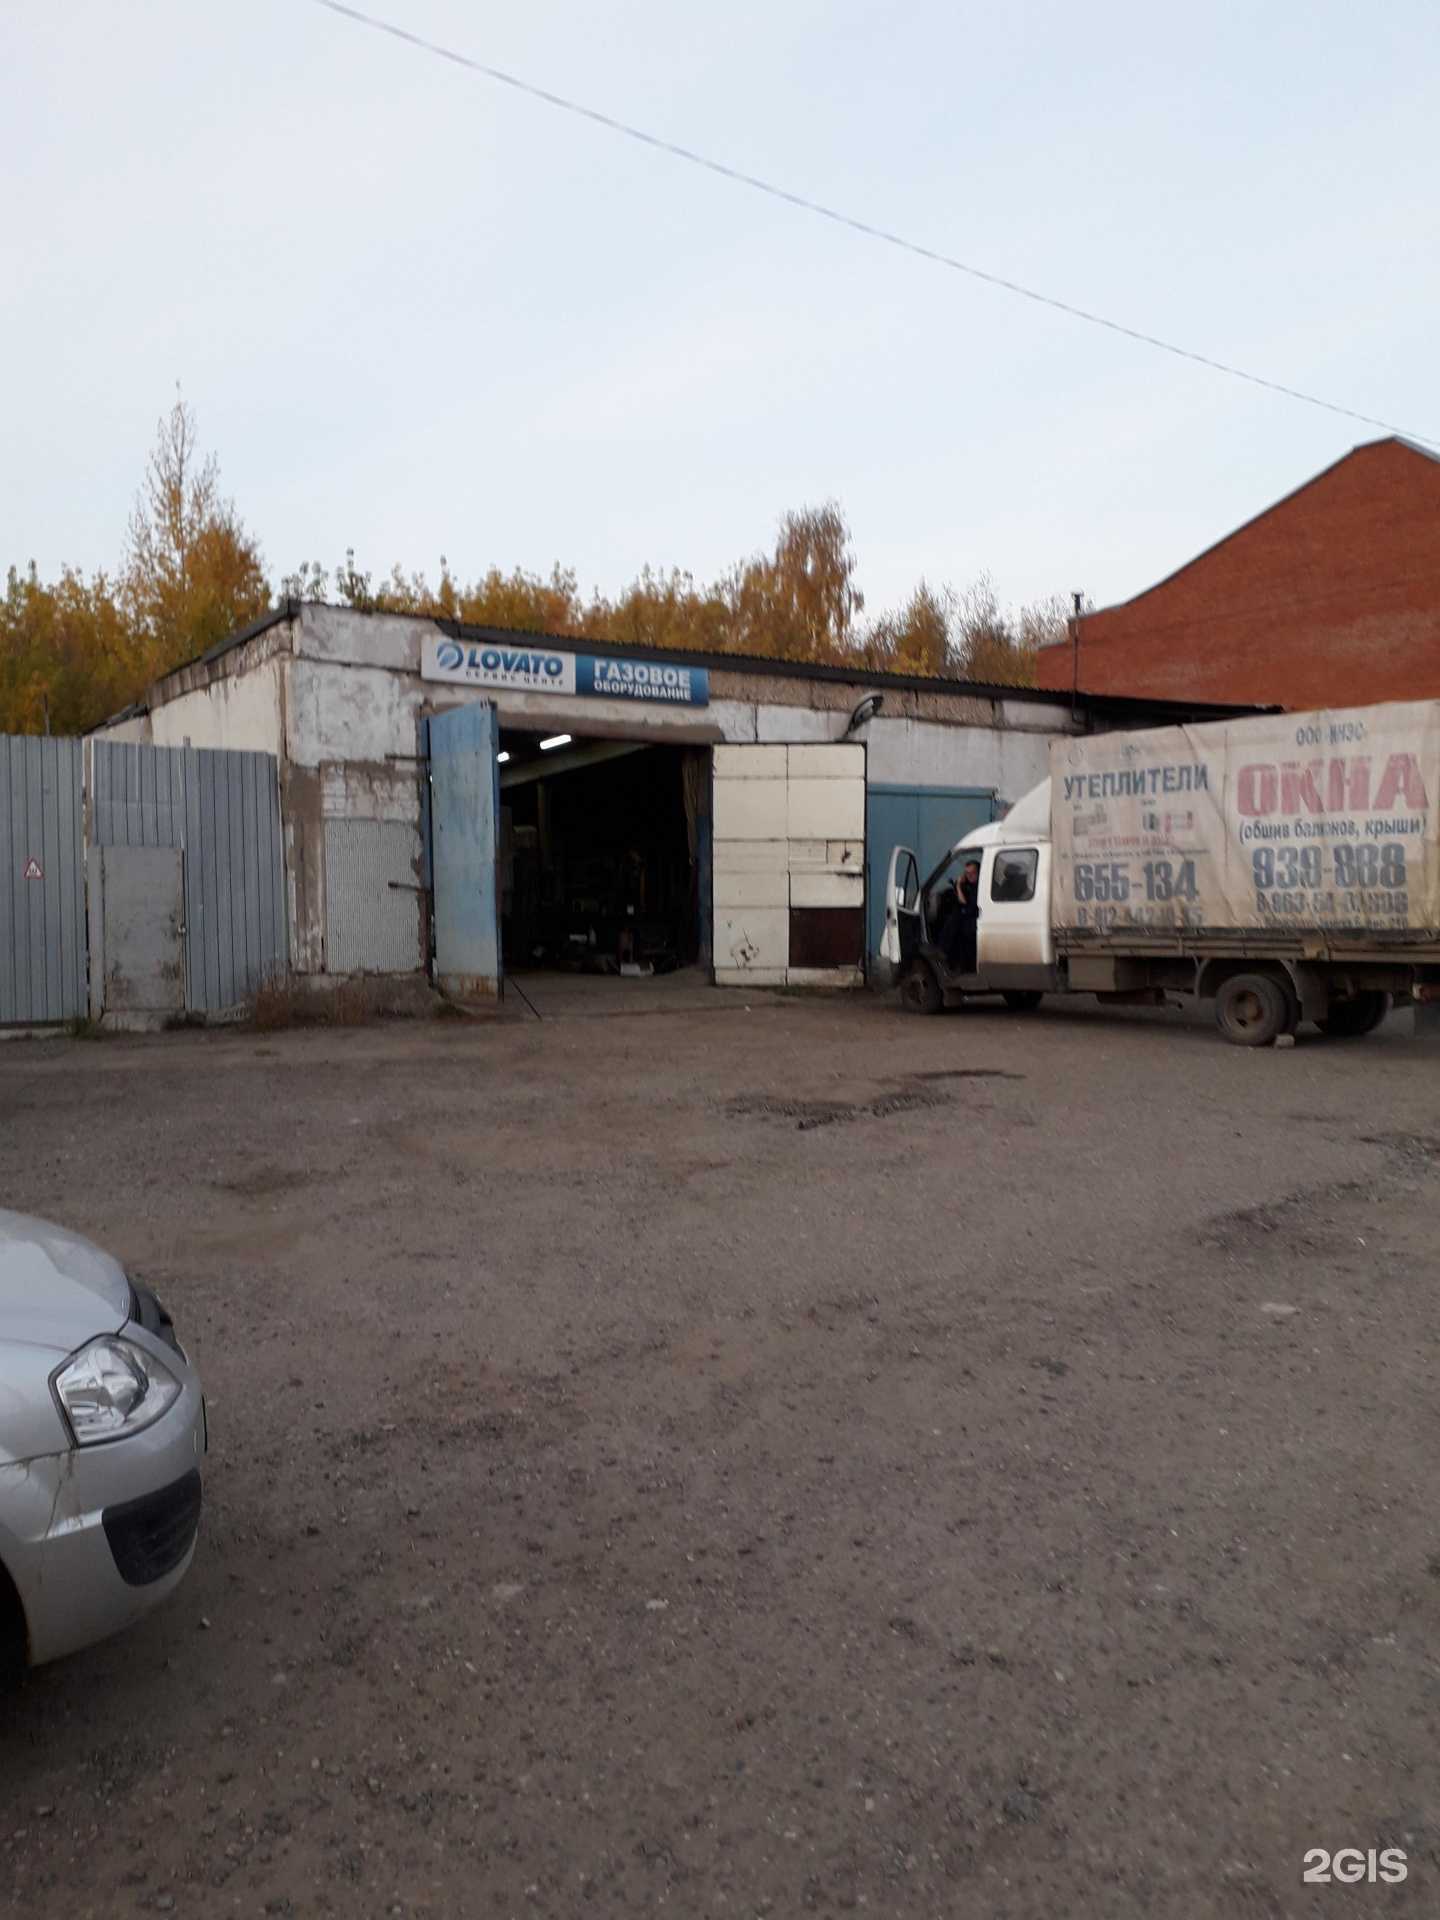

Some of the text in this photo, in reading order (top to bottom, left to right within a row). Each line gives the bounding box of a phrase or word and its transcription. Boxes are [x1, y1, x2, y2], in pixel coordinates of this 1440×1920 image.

[467, 647, 563, 676] LOVATO
[593, 659, 692, 689] ГАЗОВОЕ
[593, 680, 692, 702] ОБОРУДОВАНИЕ
[1063, 764, 1210, 801] УТЕПЛИТЕЛИ
[1237, 752, 1430, 817] ОКНА
[1365, 814, 1427, 840] крыши)
[1073, 860, 1200, 902] 655-134
[1252, 842, 1406, 890] 939-888
